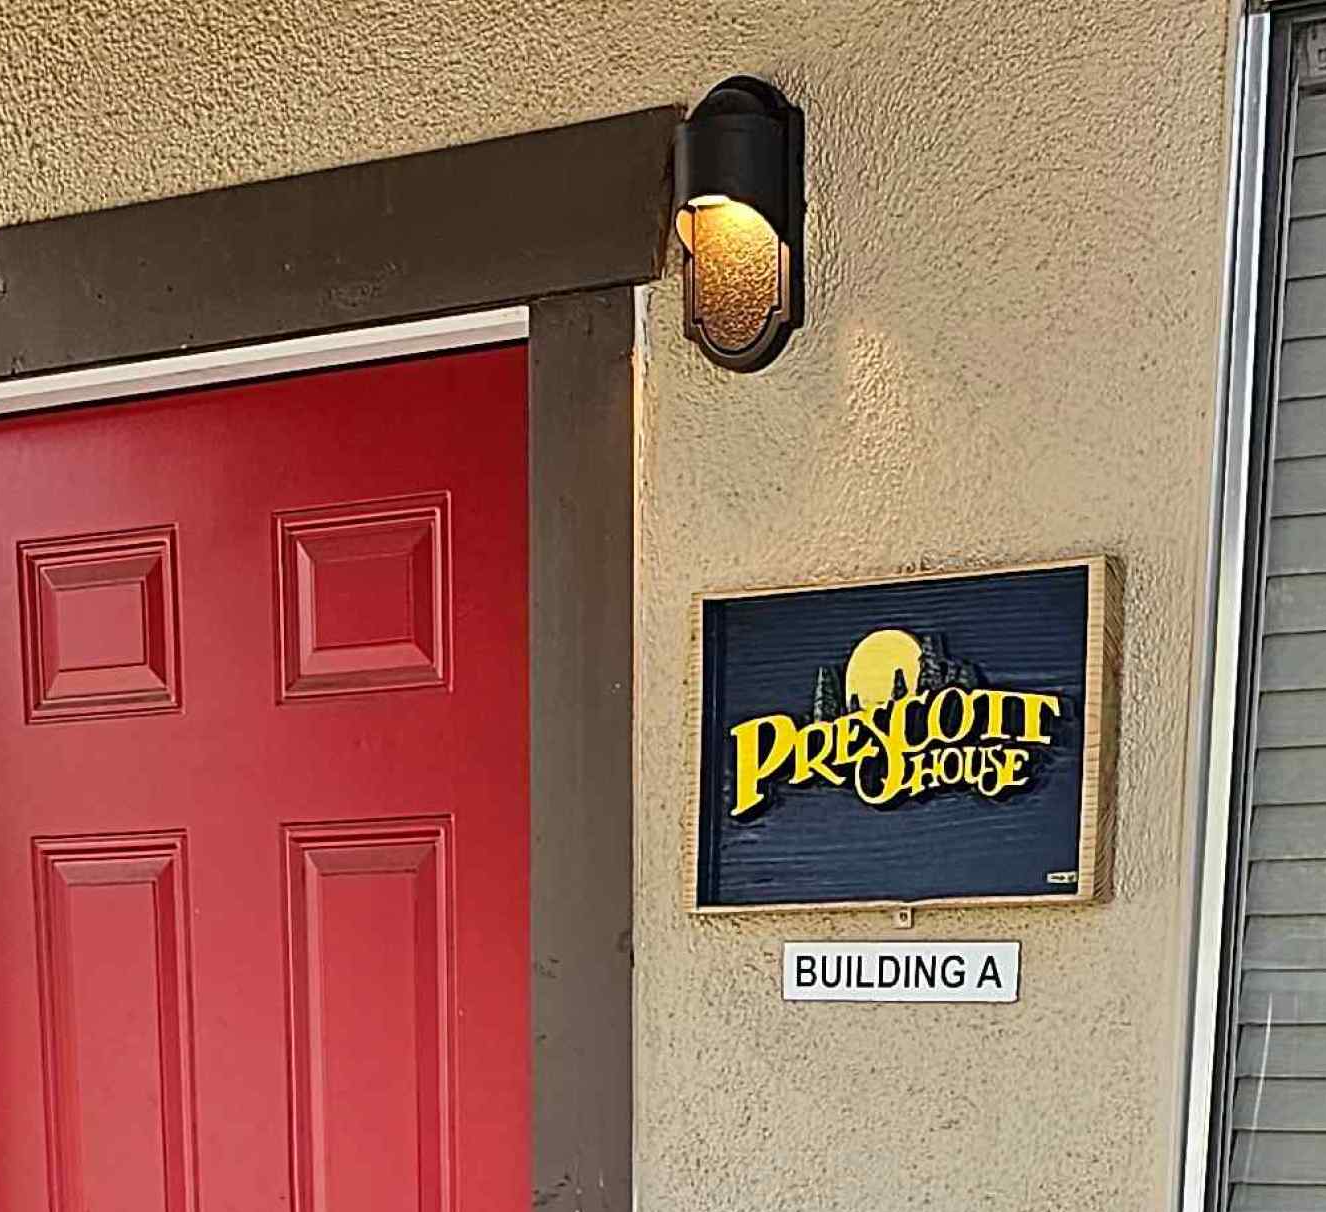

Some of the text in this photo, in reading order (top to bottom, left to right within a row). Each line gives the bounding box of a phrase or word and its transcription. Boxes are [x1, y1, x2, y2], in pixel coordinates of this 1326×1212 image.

[730, 686, 1061, 816] PRESCOTT
[909, 745, 1029, 797] HOUSE
[796, 955, 1002, 989] BUILDING A
